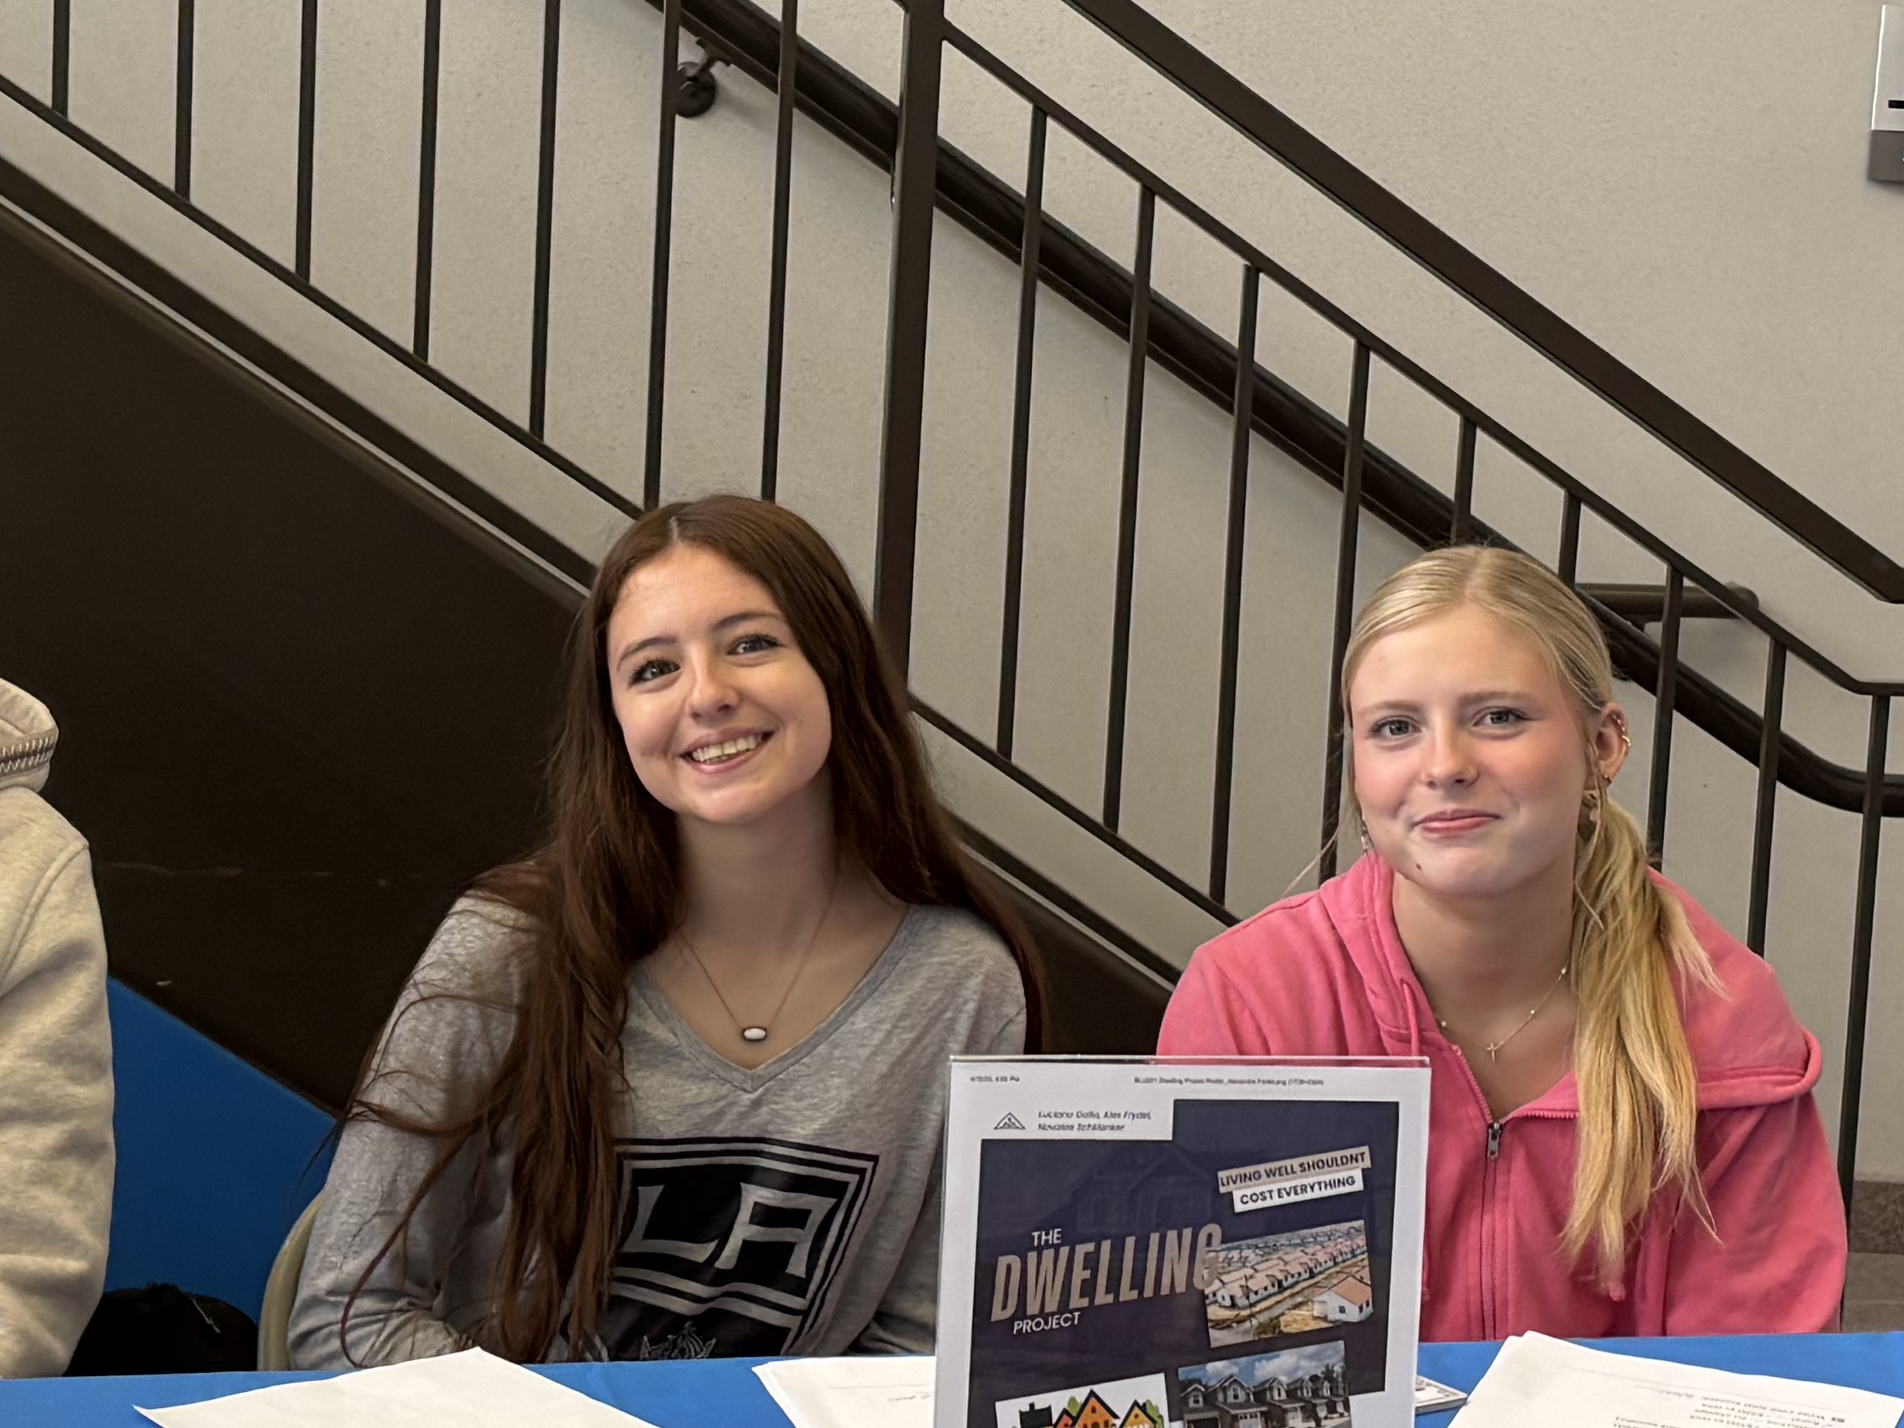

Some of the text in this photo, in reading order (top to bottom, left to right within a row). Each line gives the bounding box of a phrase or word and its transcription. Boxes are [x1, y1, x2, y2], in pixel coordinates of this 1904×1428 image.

[1220, 1151, 1367, 1188] LIVING WELL SHOULDNT
[1239, 1175, 1357, 1206] COST EVERYTHING
[622, 1181, 839, 1279] LA
[1031, 1227, 1064, 1249] THE
[990, 1222, 1224, 1323] DWELLING
[1012, 1311, 1082, 1336] PROJECT
